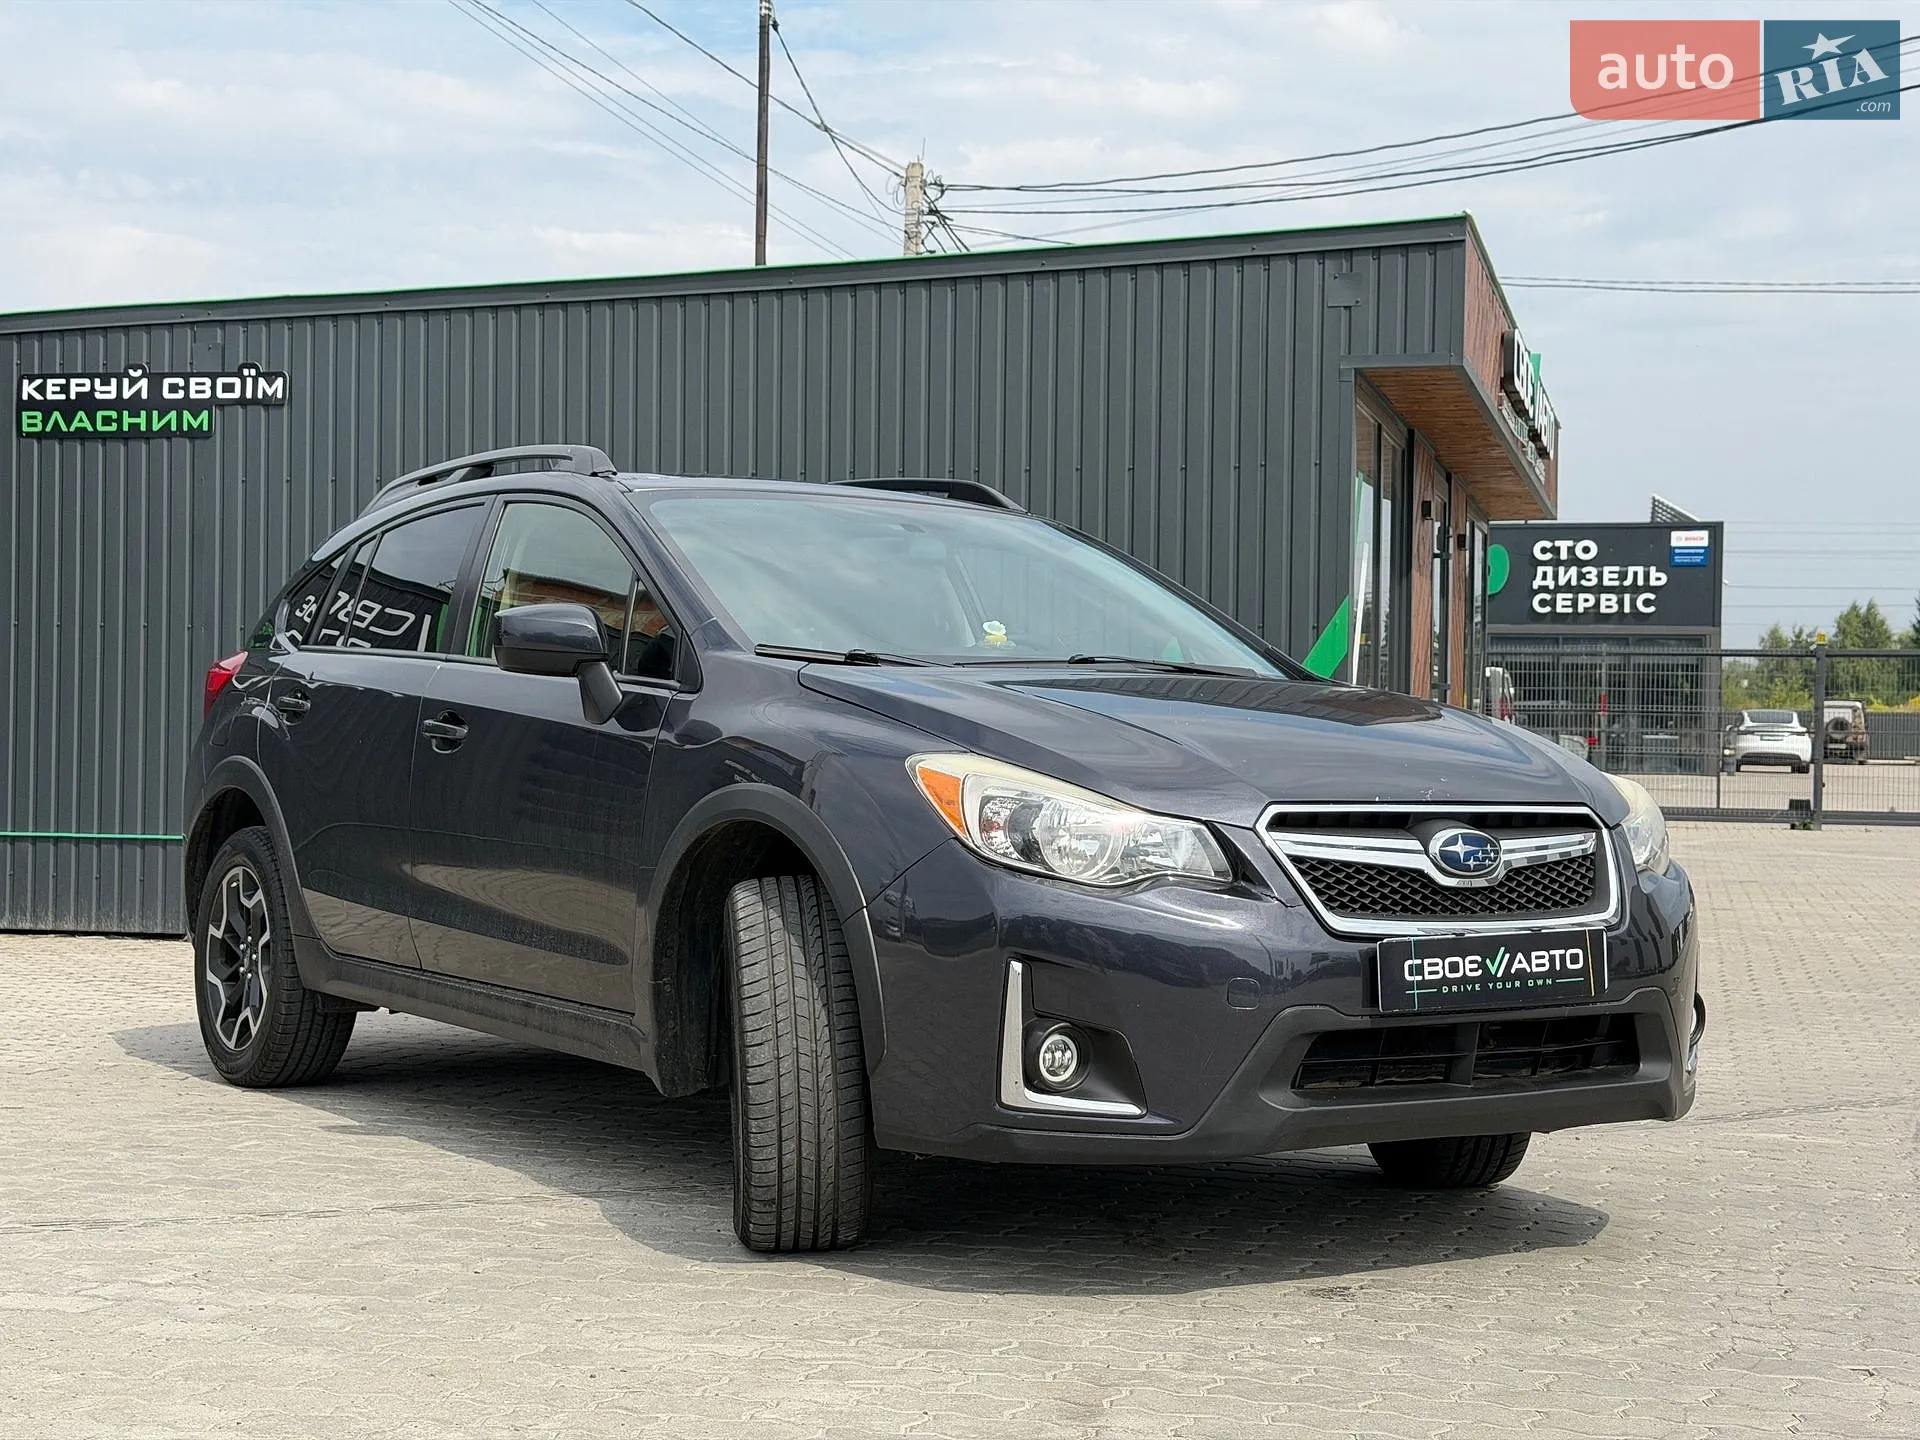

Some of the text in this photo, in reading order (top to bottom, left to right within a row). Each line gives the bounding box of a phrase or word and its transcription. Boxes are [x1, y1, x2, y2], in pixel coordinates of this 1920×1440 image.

[22, 368, 284, 401] КЕРУЙ СВОЇМ
[21, 410, 210, 432] ВЛАСНИМ
[1532, 539, 1598, 561] СТО
[1532, 565, 1668, 590] ДИЗЕЛЬ
[1531, 592, 1657, 614] СЕРВІС
[1442, 978, 1553, 994] DRIVE YOUR OWN
